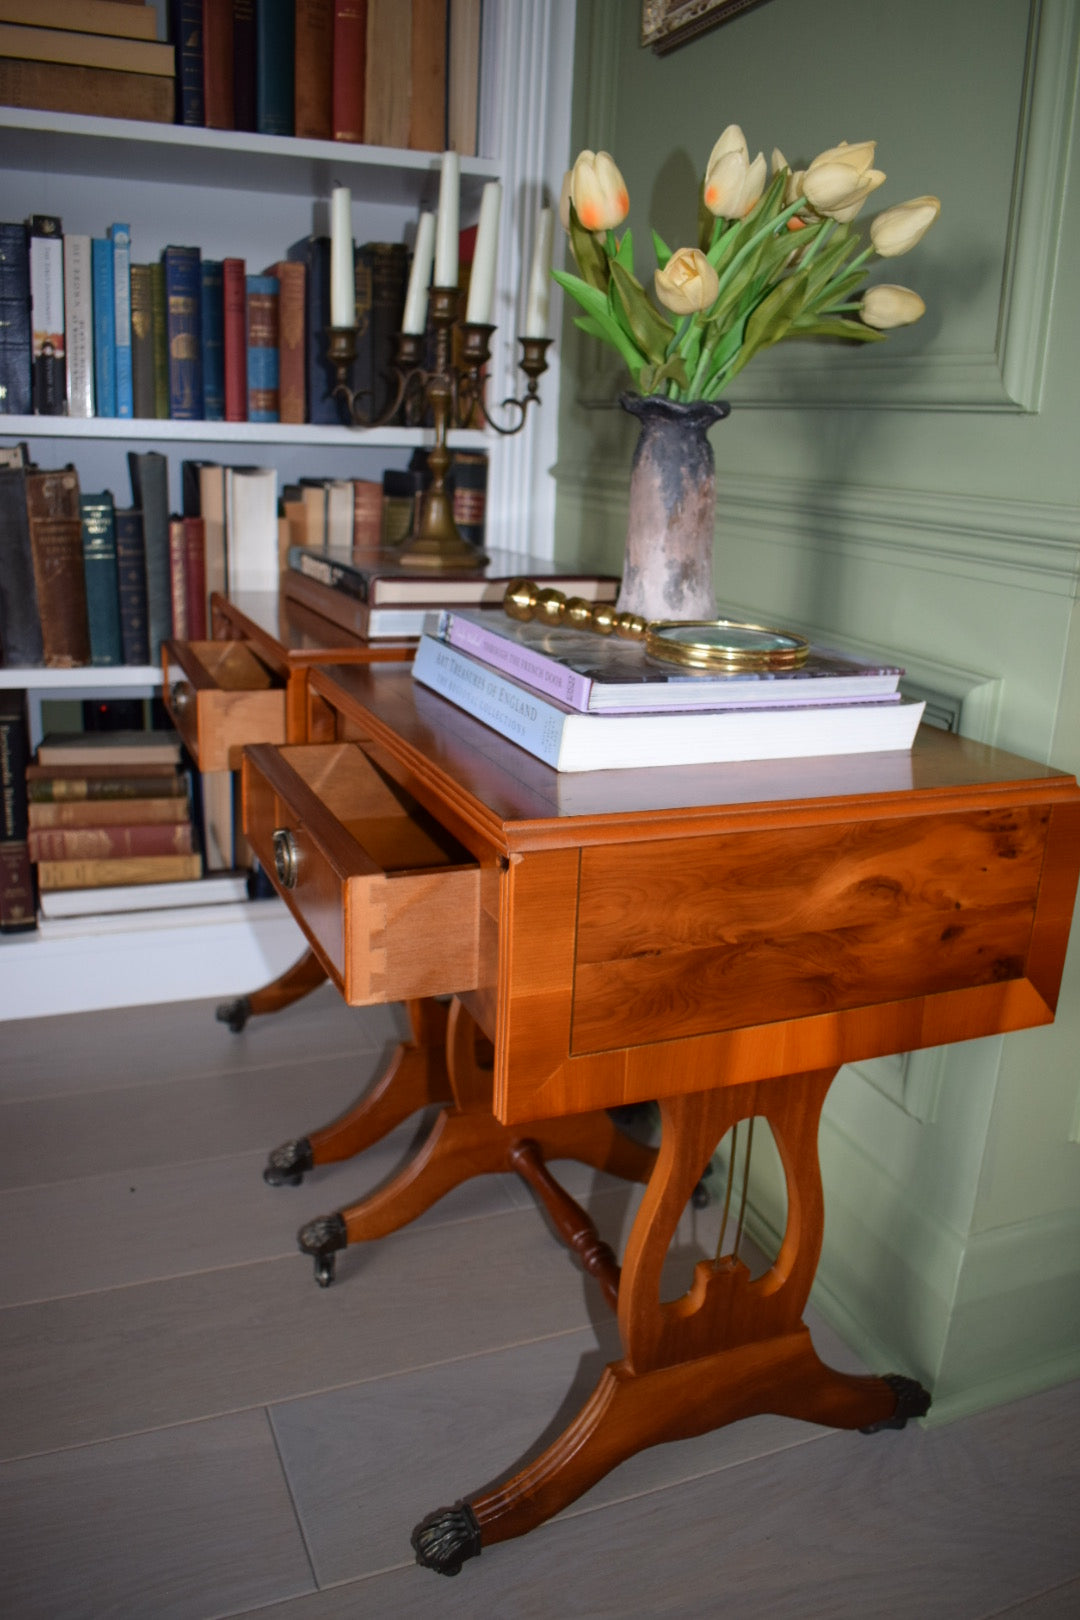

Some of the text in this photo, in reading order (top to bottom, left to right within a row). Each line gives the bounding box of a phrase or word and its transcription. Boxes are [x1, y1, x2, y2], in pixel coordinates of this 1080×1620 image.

[436, 651, 450, 667] ART
[449, 657, 486, 690] TREASURES
[486, 681, 497, 698] OF
[498, 687, 538, 722] ENGLAND
[479, 698, 527, 737] COLLECTIONS
